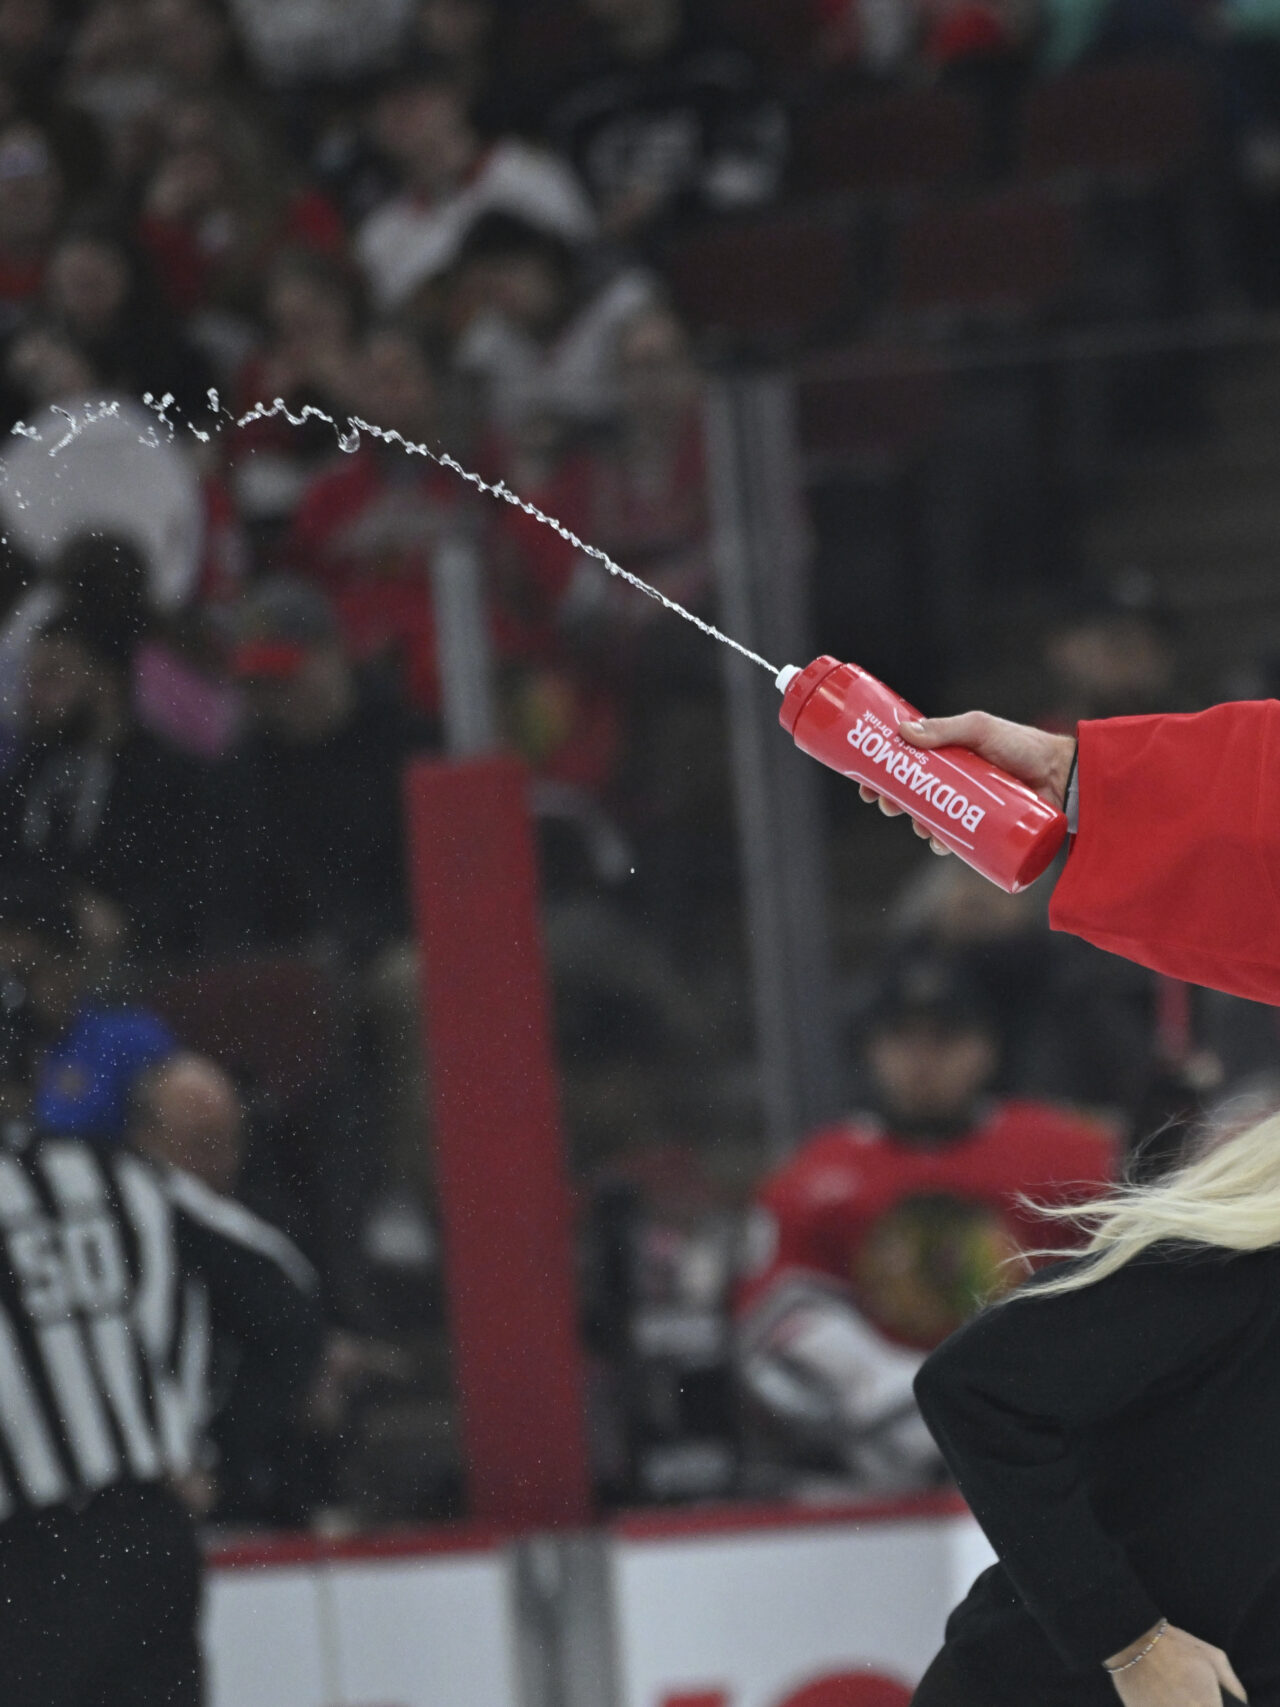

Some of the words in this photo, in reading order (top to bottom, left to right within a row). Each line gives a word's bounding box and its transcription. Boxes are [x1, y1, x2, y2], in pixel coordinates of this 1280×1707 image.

[863, 710, 894, 738] Drink
[893, 735, 929, 765] Sports
[847, 718, 986, 833] BODYARMOR
[8, 1221, 125, 1312] 50
